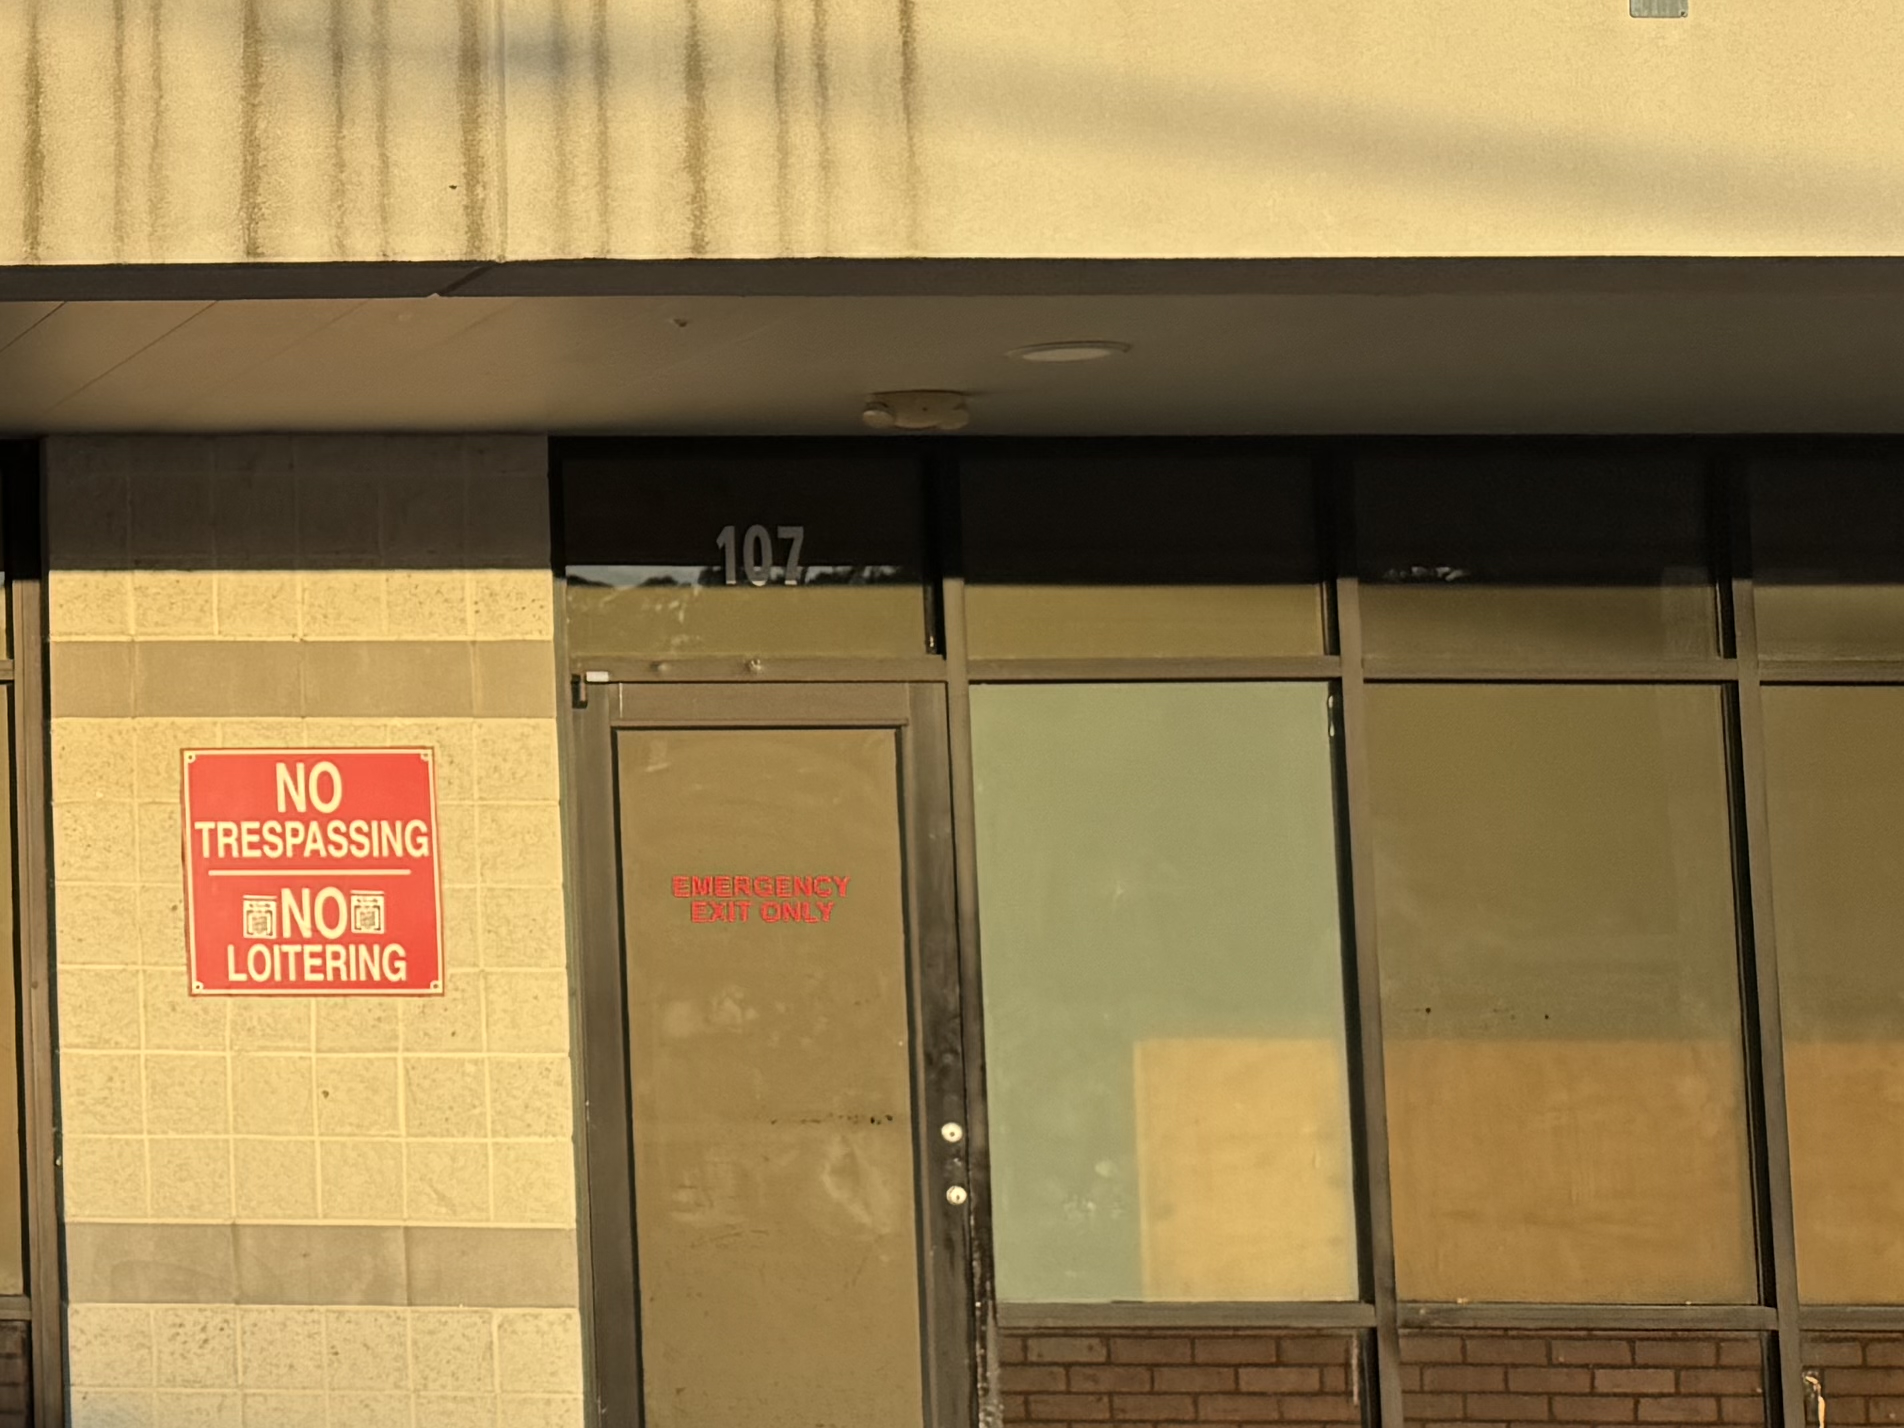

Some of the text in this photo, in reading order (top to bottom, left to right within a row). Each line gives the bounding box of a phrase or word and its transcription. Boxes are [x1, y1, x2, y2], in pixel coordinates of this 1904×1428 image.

[715, 525, 806, 587] 107
[275, 760, 343, 814] NO
[194, 819, 430, 859] TRESPASSING
[671, 875, 851, 900] EMERGENCY
[280, 886, 348, 940] NO
[689, 899, 835, 924] EXIT ONLY
[227, 943, 407, 983] LOITERING
